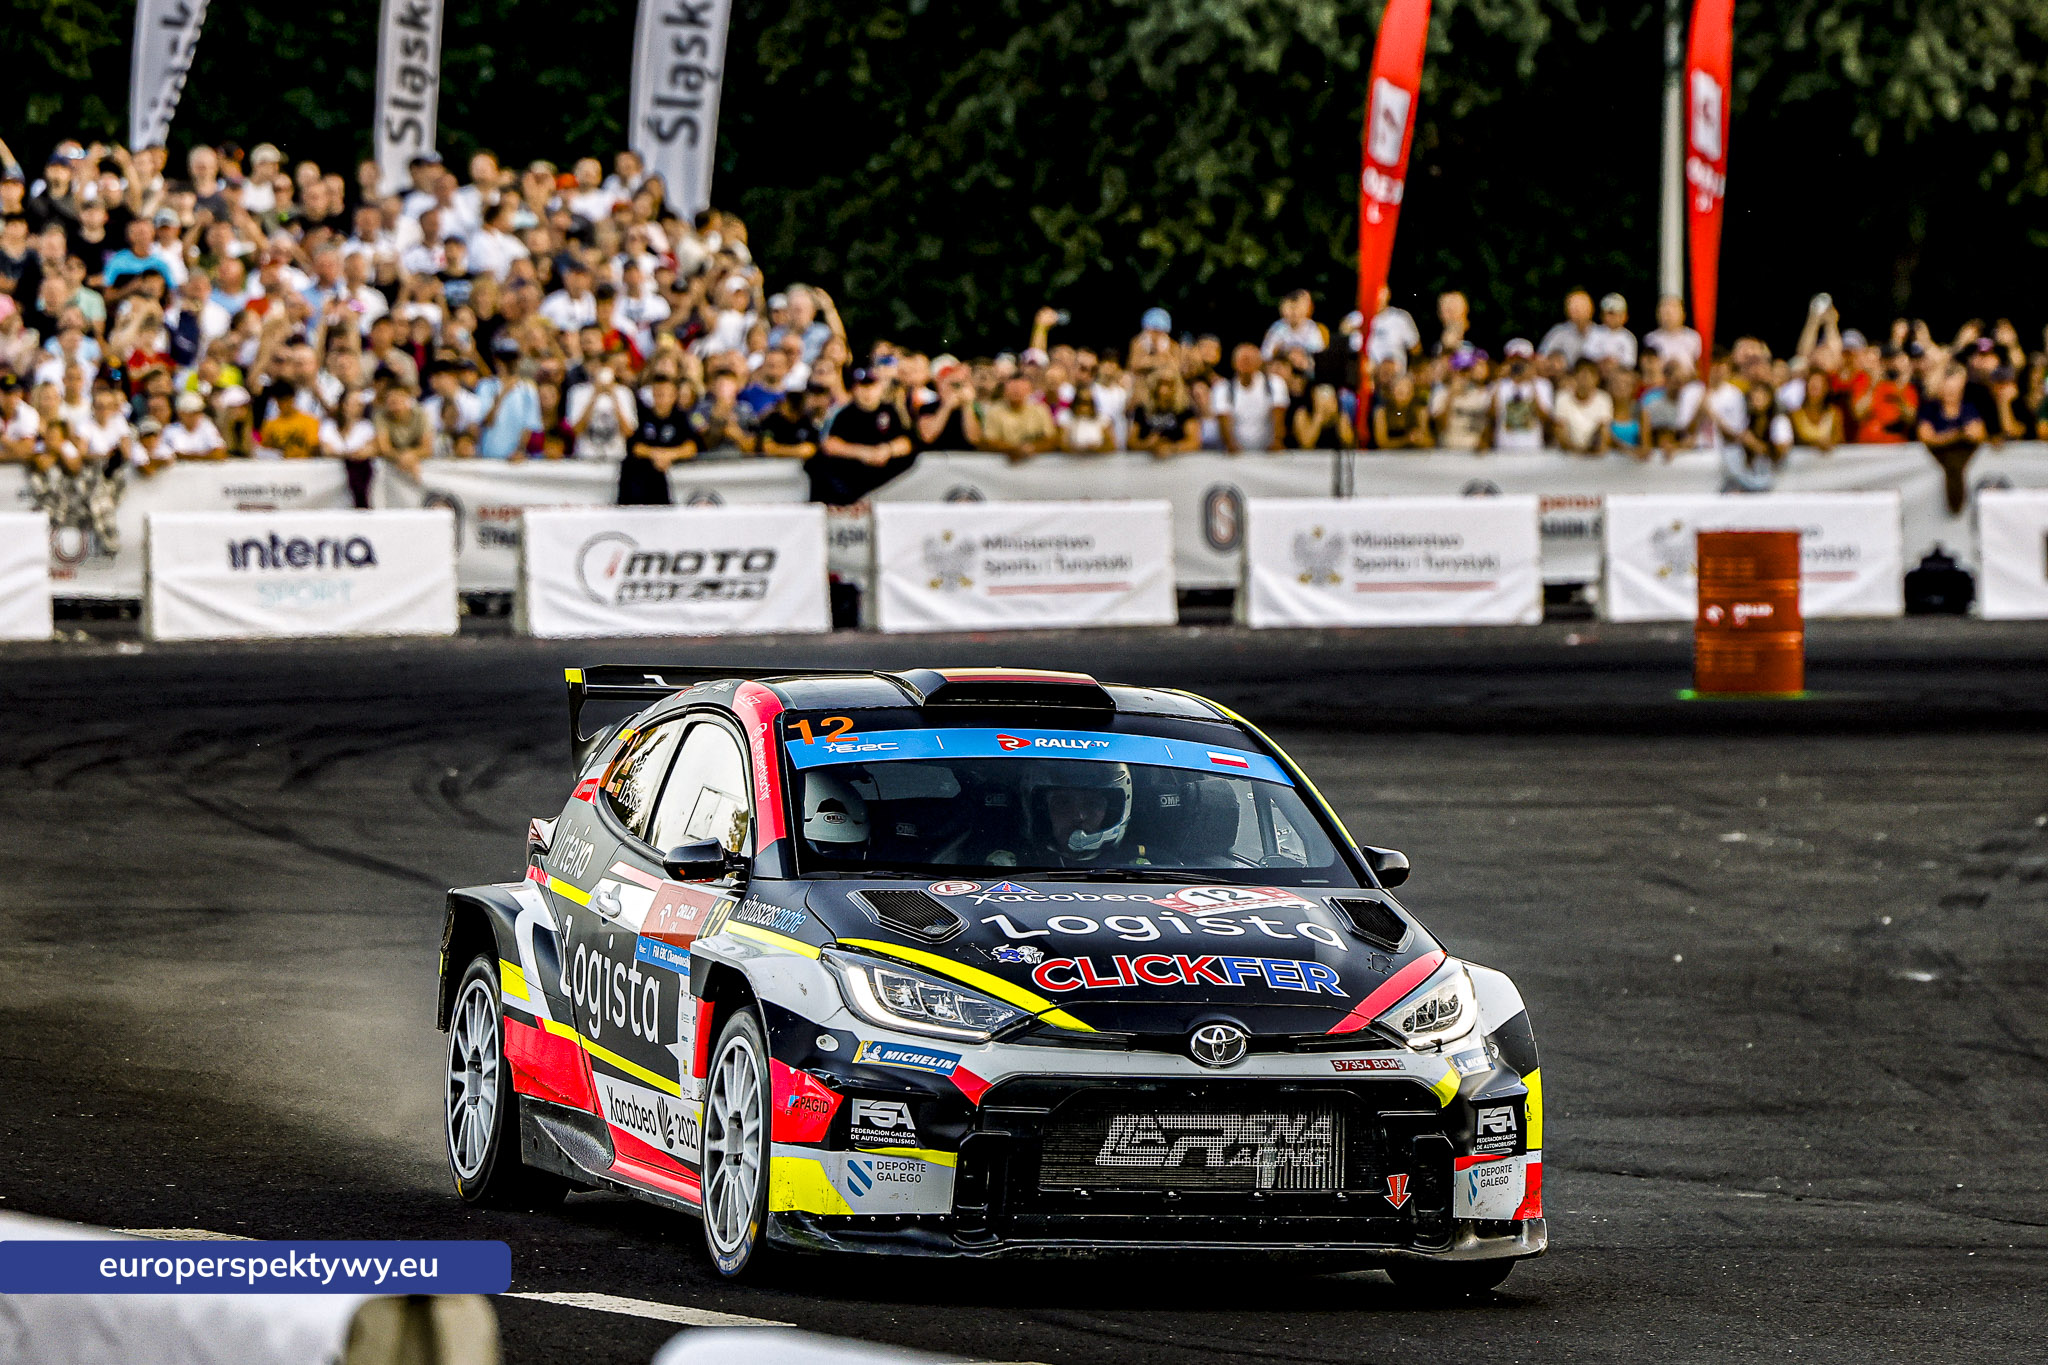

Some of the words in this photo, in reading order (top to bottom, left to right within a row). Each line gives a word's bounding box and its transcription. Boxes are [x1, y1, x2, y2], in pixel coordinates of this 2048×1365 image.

[227, 530, 378, 571] interia
[787, 716, 859, 745] 12
[548, 819, 595, 880] Arteixo
[966, 891, 1154, 906] Xacobeo
[1188, 888, 1255, 902] 12
[676, 903, 699, 921] ORLEN
[980, 910, 1350, 952] Logista
[558, 914, 660, 1044] Logista
[1031, 954, 1351, 998] CLICKFER
[882, 1050, 958, 1070] MICHELIN
[1372, 1059, 1397, 1069] BCM
[606, 1085, 657, 1136] Xacobeo
[800, 1096, 830, 1114] PAGID
[860, 1135, 916, 1145] AUTOMOBILISMO
[876, 1161, 927, 1173] DEPORTE
[1480, 1164, 1513, 1178] DEPORTE
[876, 1172, 922, 1183] GALEGO
[1480, 1175, 1509, 1188] GALEGO
